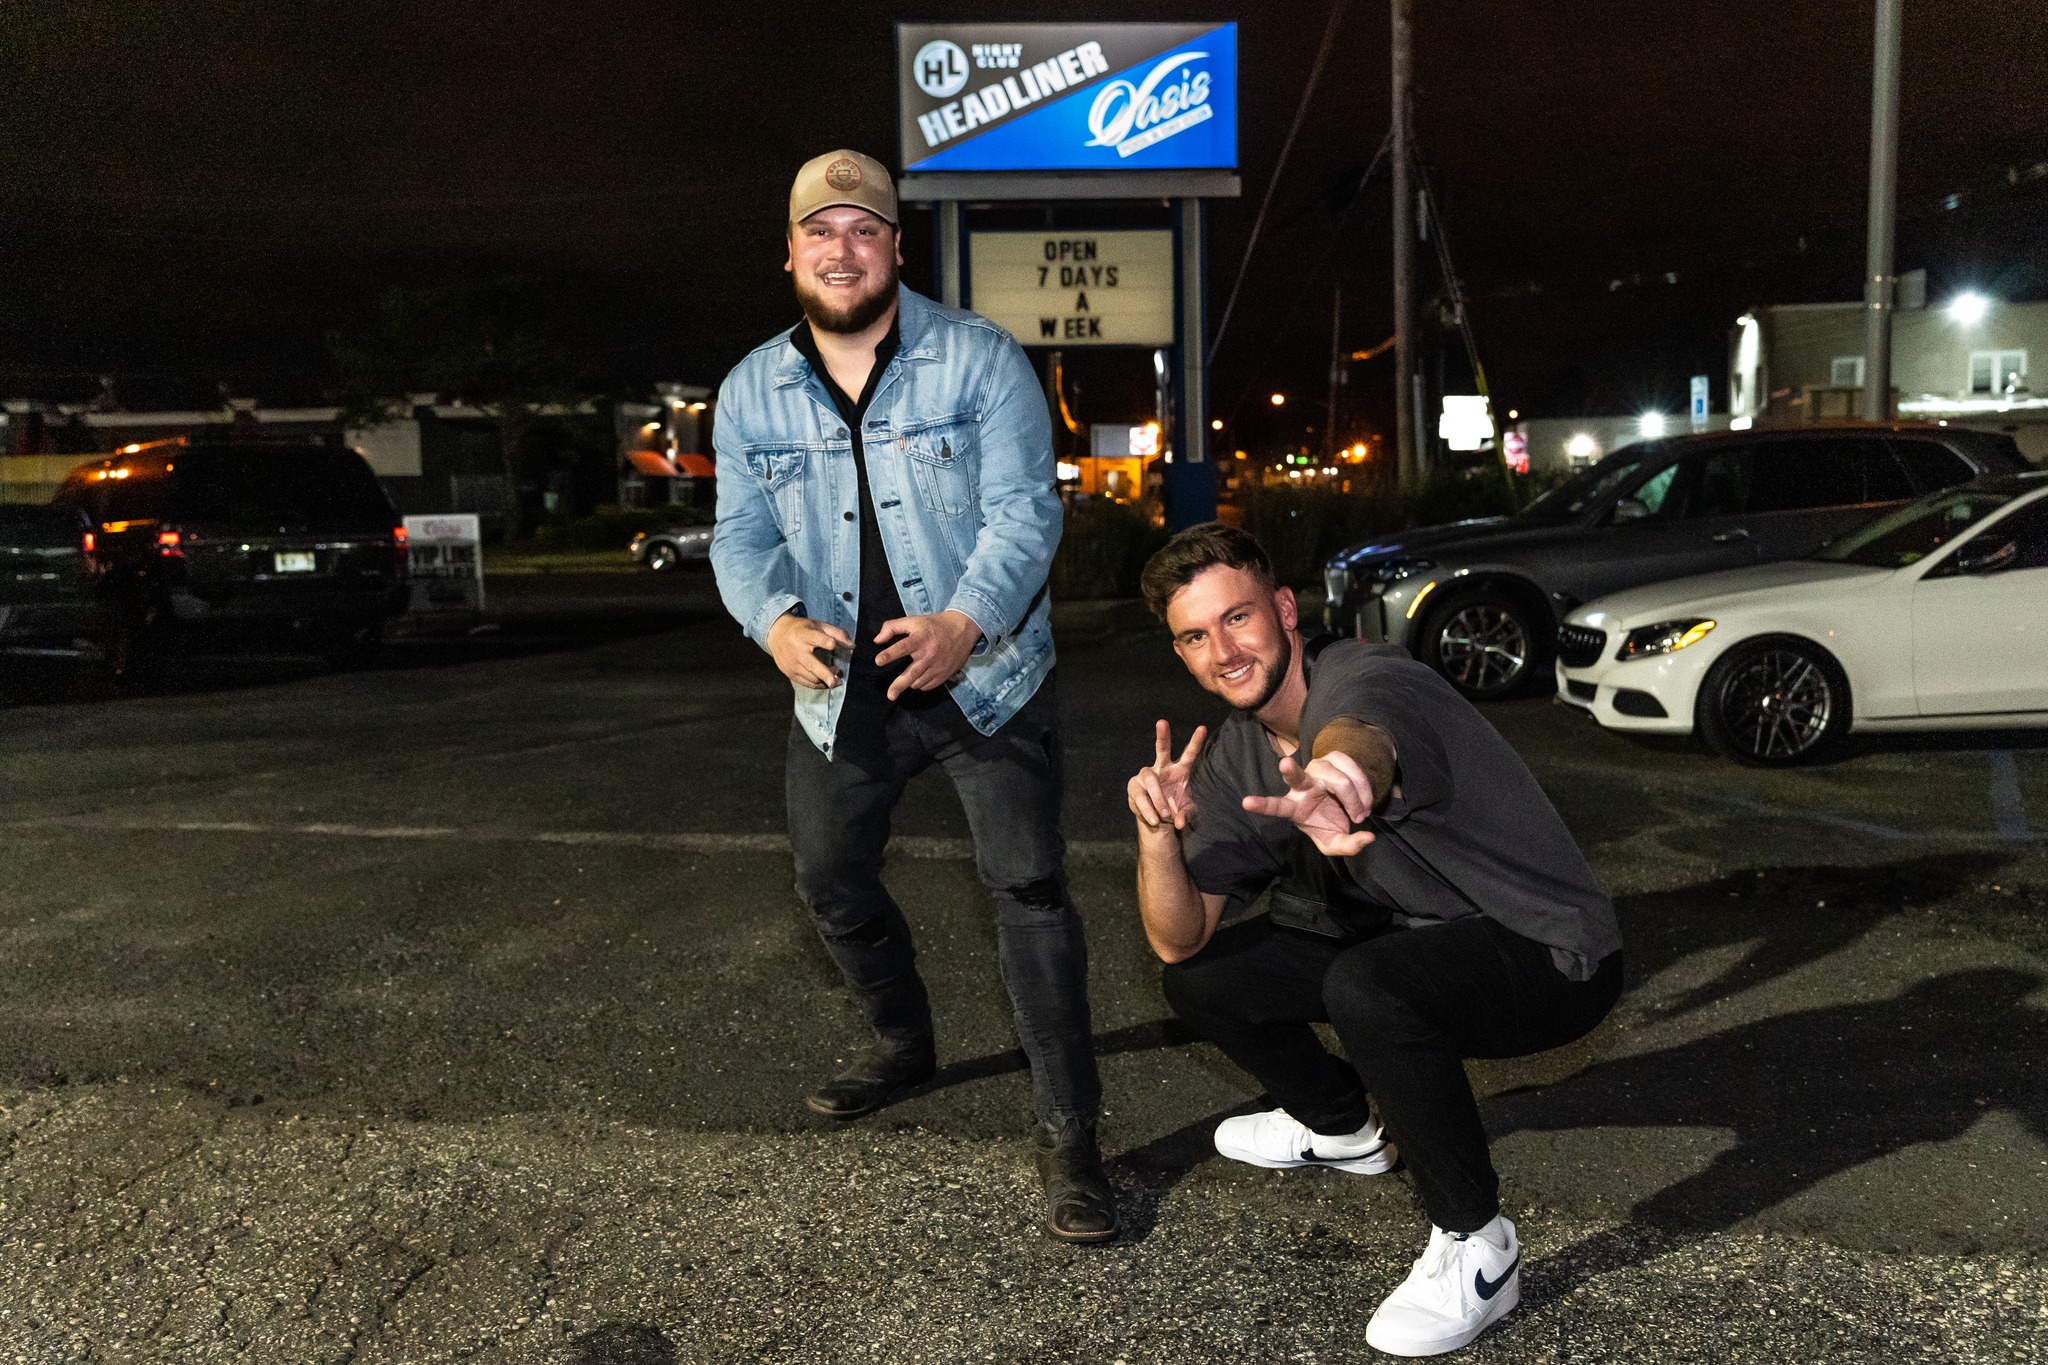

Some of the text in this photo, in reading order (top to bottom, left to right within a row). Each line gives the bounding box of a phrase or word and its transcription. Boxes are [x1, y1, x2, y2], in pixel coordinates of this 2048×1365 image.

[923, 49, 961, 86] HL
[918, 41, 1109, 147] HEADLINER
[1083, 51, 1212, 147] Oasis
[1045, 242, 1096, 260] OPEN
[1038, 267, 1118, 287] 7 DAYS
[1075, 292, 1090, 313] A
[1040, 318, 1101, 339] WEEK
